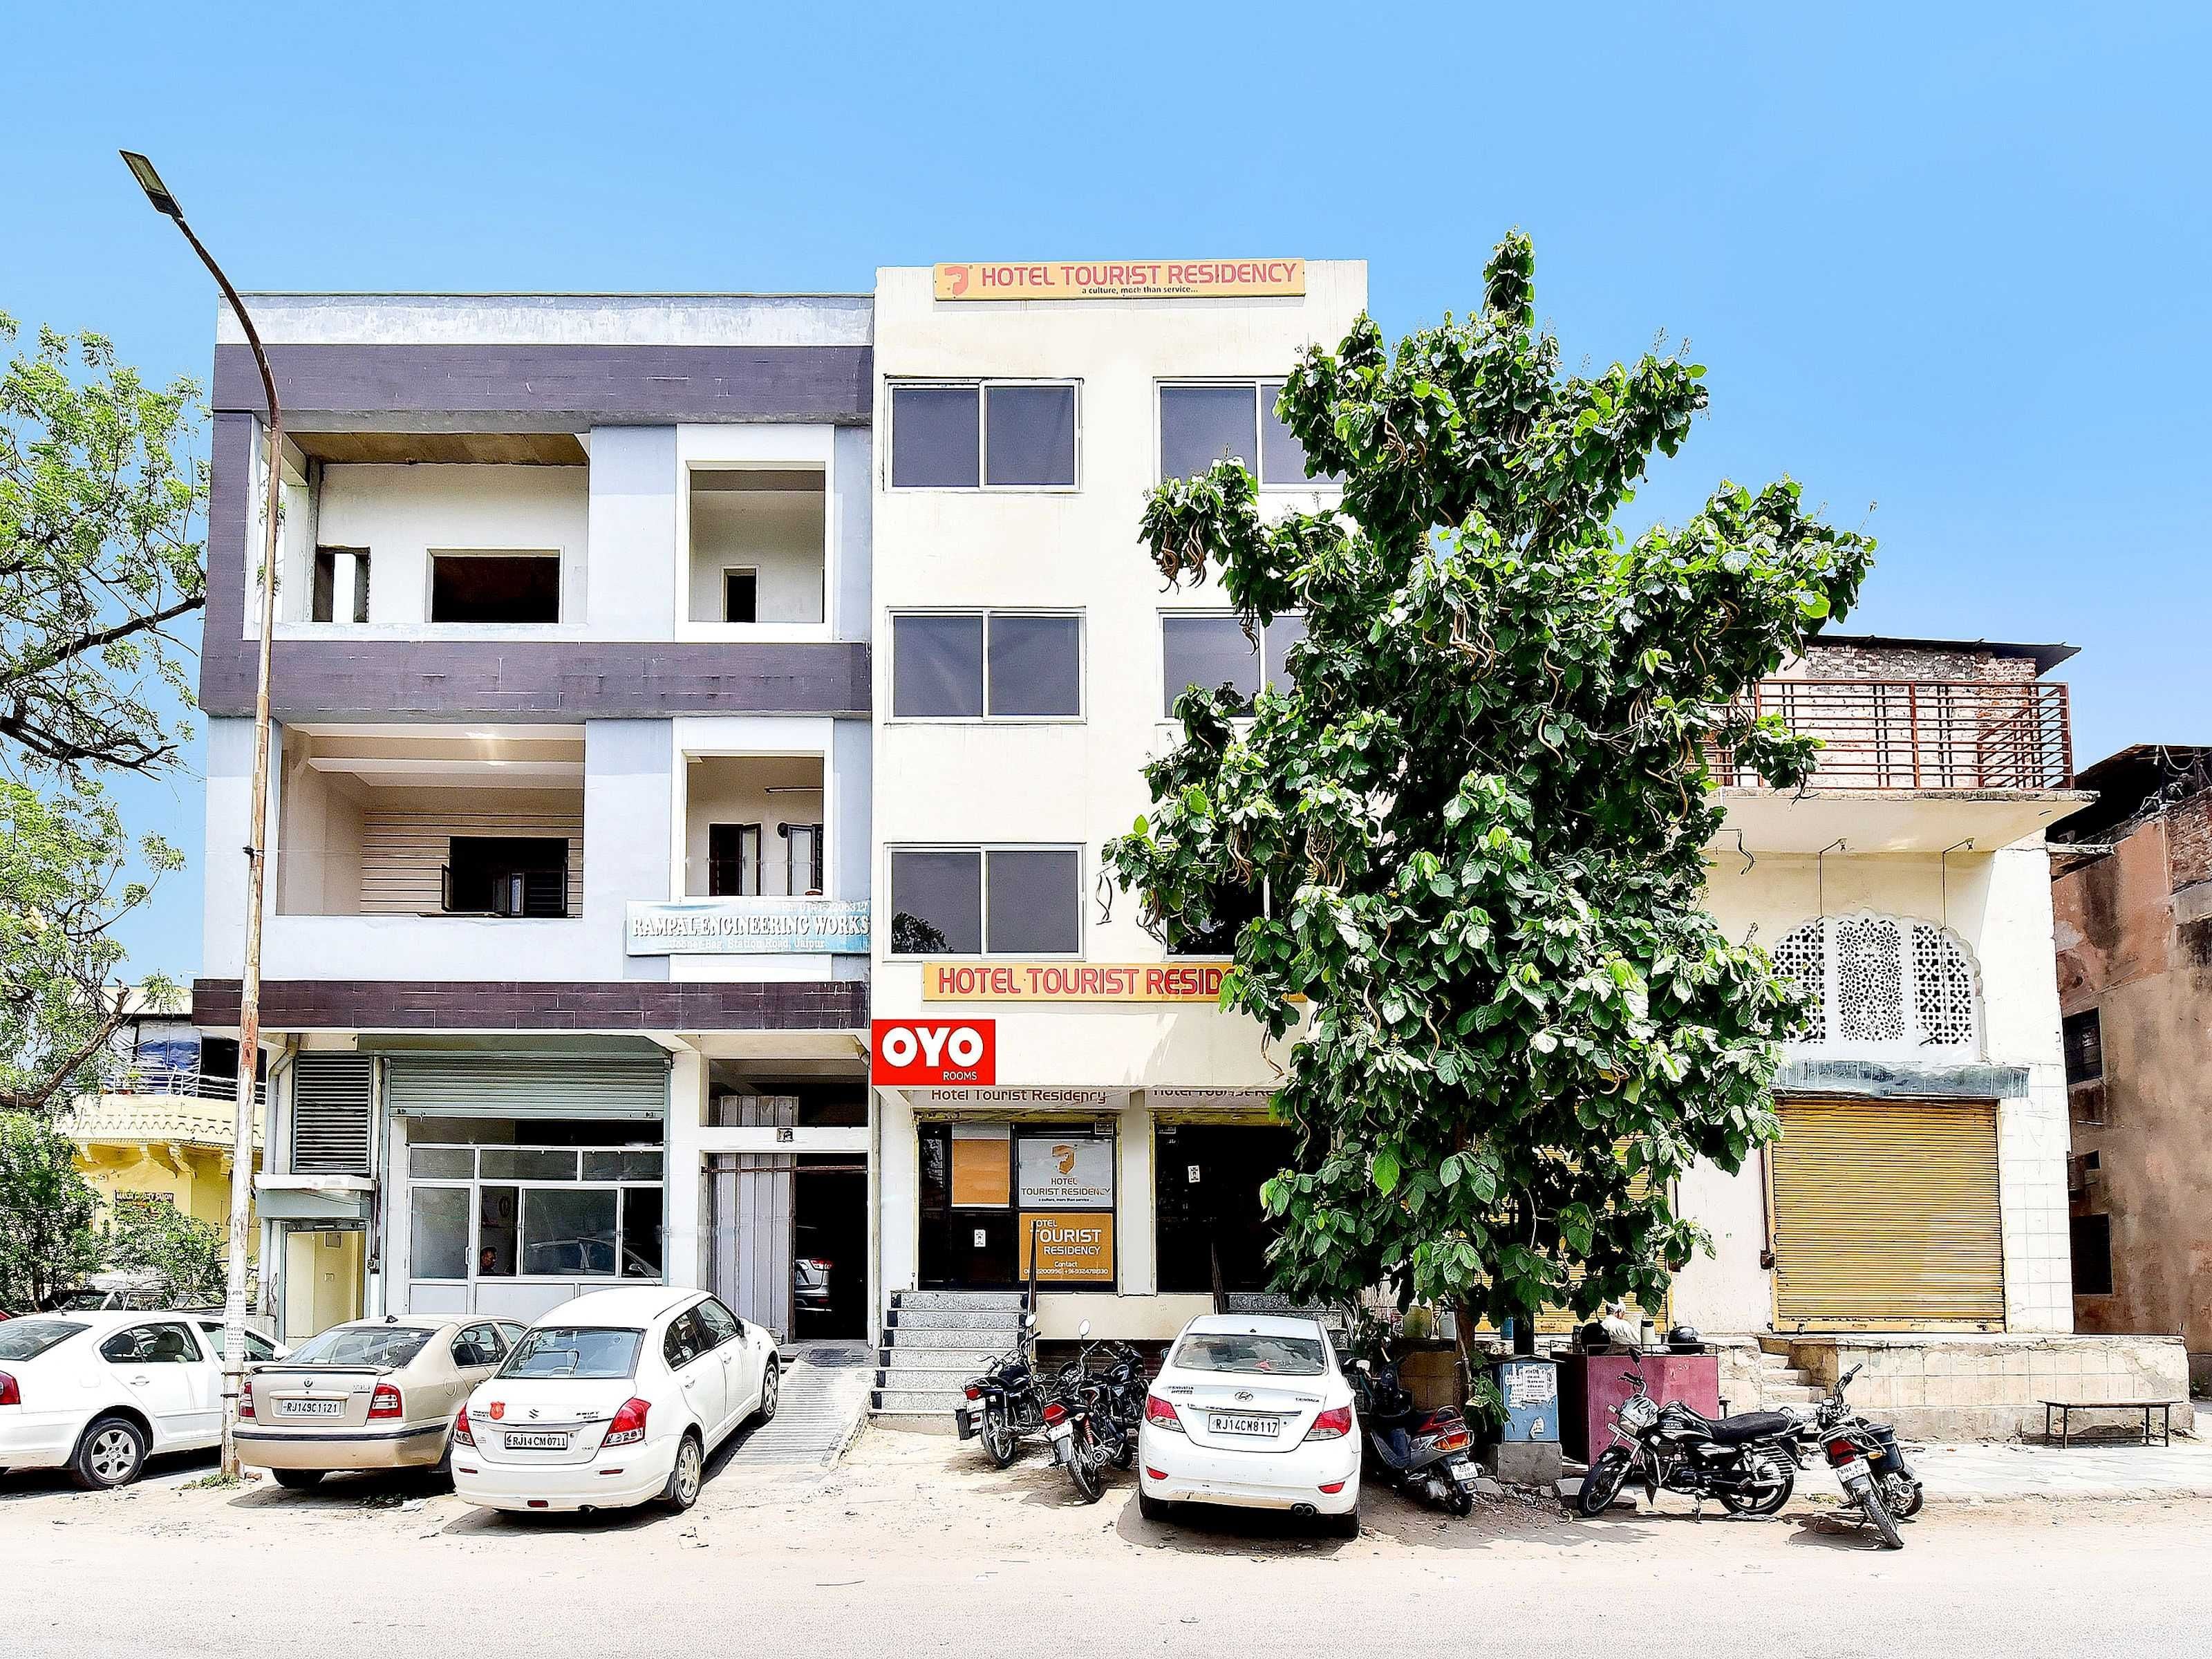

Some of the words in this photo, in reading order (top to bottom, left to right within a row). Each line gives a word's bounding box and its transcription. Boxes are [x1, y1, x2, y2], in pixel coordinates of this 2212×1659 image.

[982, 267, 1056, 286] HOTEL
[1060, 265, 1161, 285] TOURIST
[1168, 263, 1297, 284] RESIDENCY
[814, 915, 870, 935] WORKS
[939, 968, 1021, 994] HOTEL
[1027, 968, 1139, 994] TOURIST
[1147, 969, 1235, 995] RESID
[881, 1027, 984, 1067] OYO
[943, 1071, 977, 1081] ROOMS
[932, 1089, 968, 1100] Hotel
[975, 1089, 1028, 1100] Tourist
[1032, 1089, 1106, 1104] Residency
[1051, 1177, 1078, 1185] HOTEL
[1022, 1188, 1059, 1196] TOURIST
[1061, 1188, 1111, 1196] RESIDENCY
[1044, 1246, 1101, 1255] RESIDENCY
[513, 1436, 532, 1446] RJ14
[534, 1436, 547, 1446] CM
[547, 1436, 566, 1447] 0711
